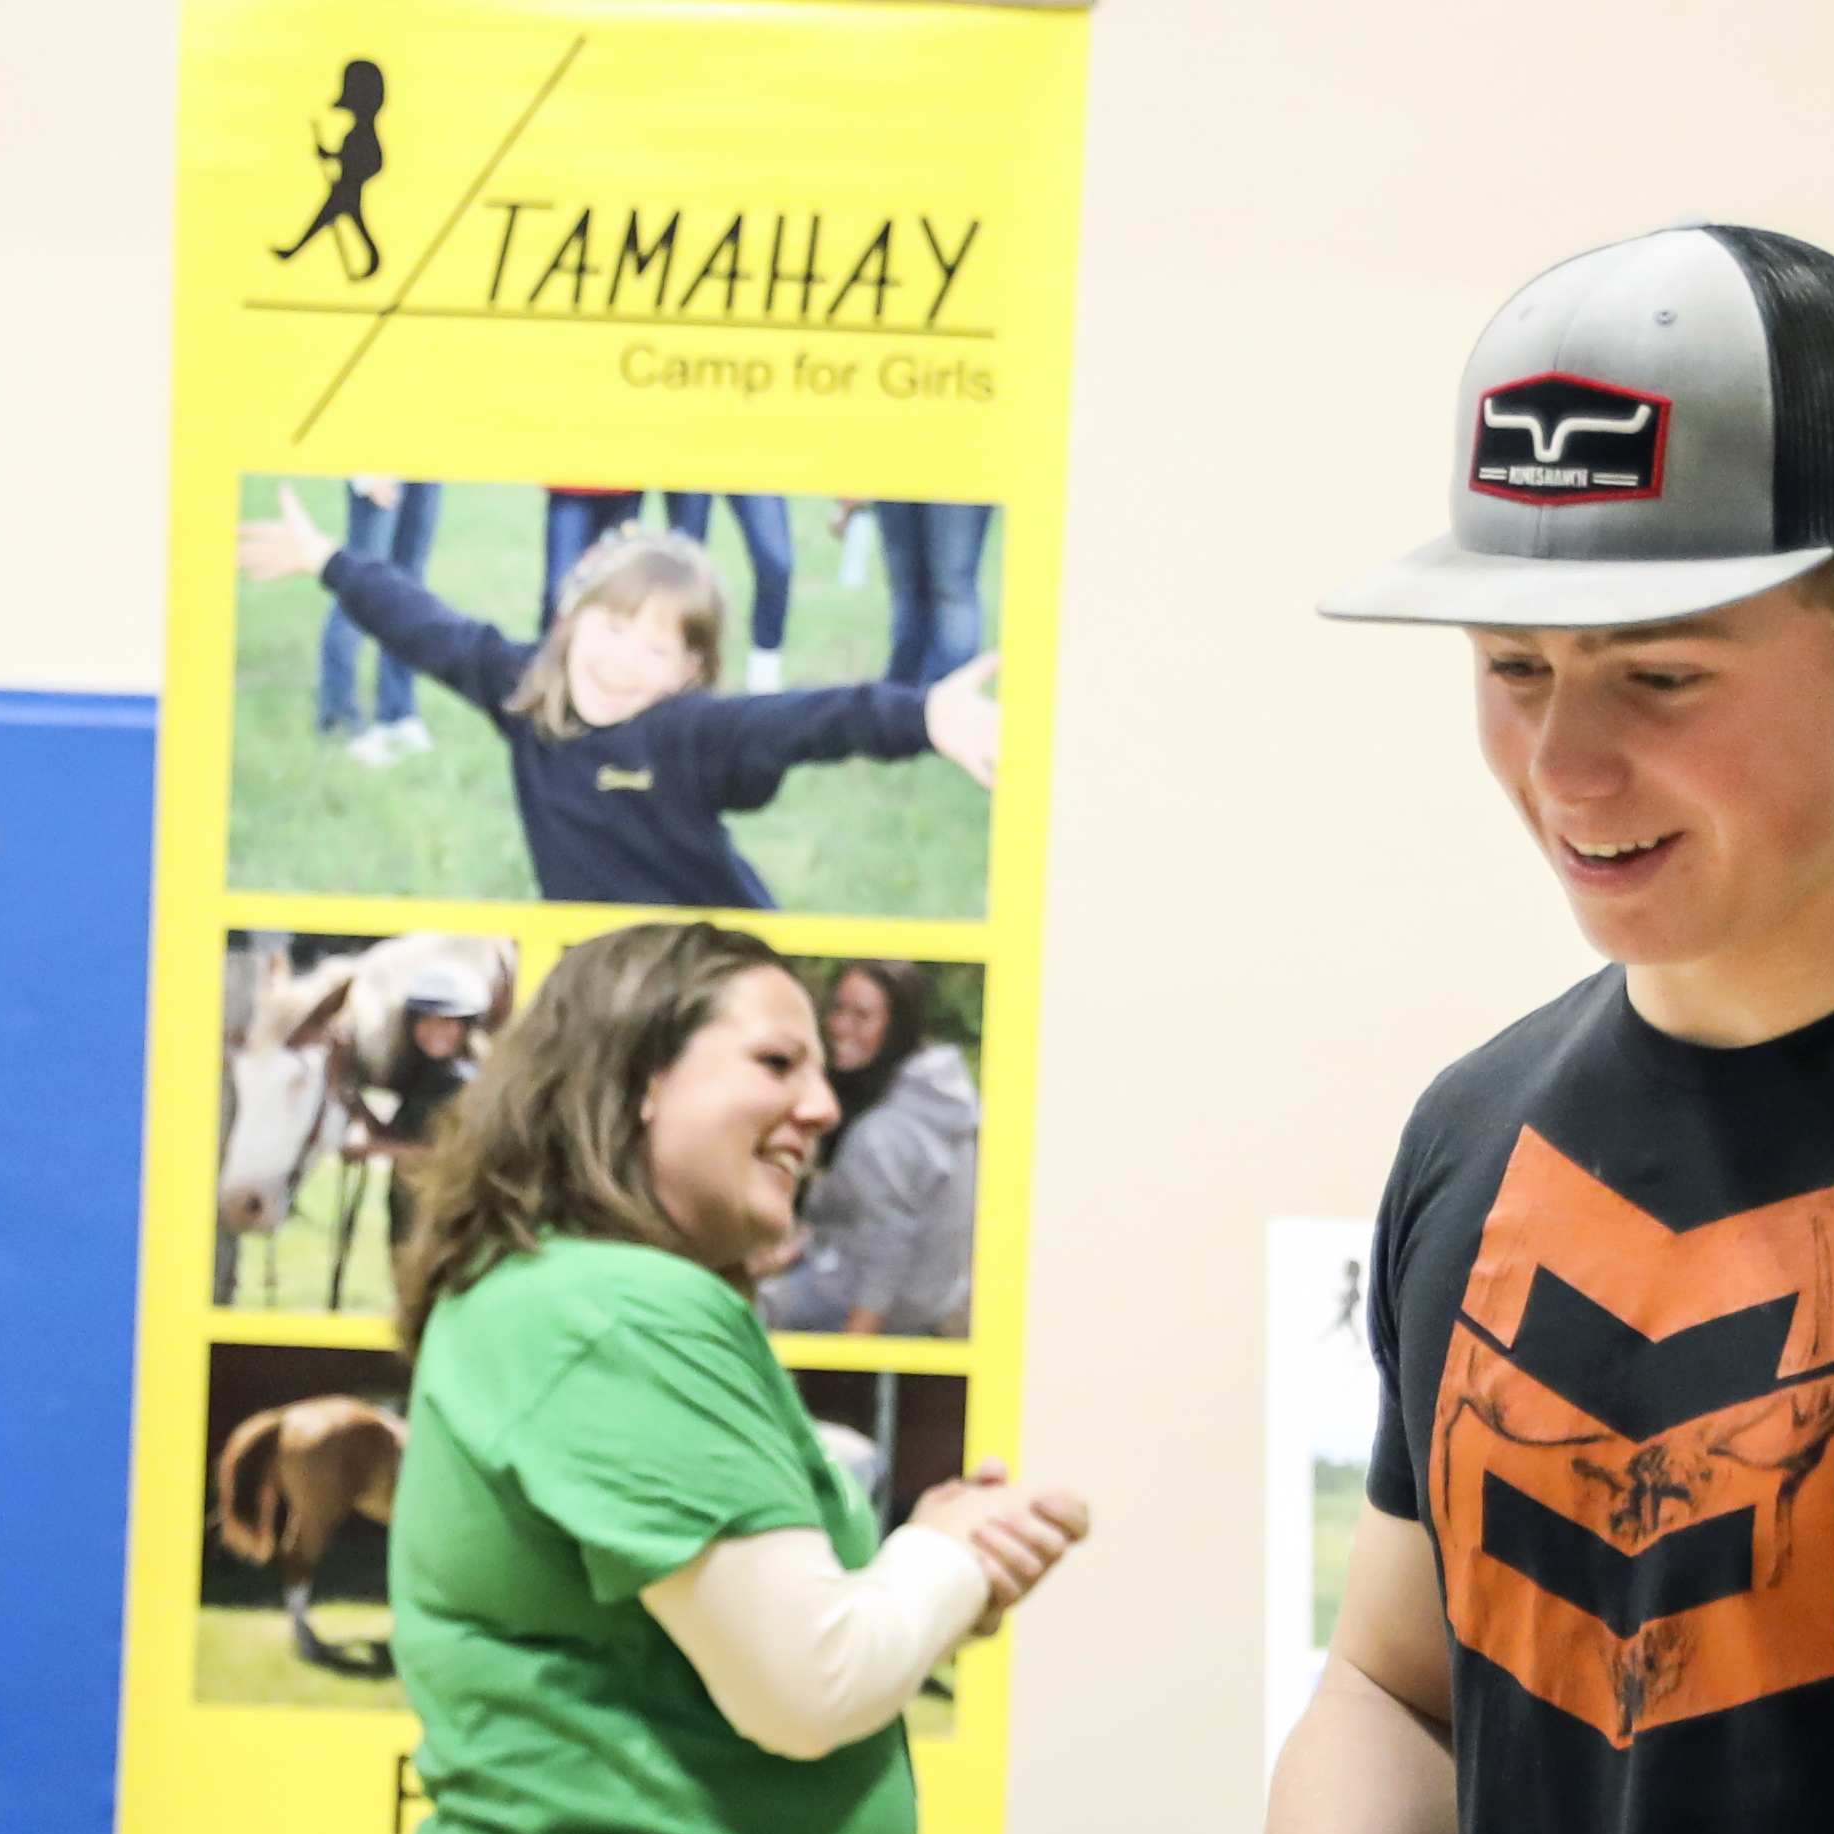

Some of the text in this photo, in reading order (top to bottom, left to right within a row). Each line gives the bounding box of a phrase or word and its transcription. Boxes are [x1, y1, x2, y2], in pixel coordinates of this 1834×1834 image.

[484, 199, 982, 328] TAMAHAY
[618, 342, 996, 403] Camp for Girls
